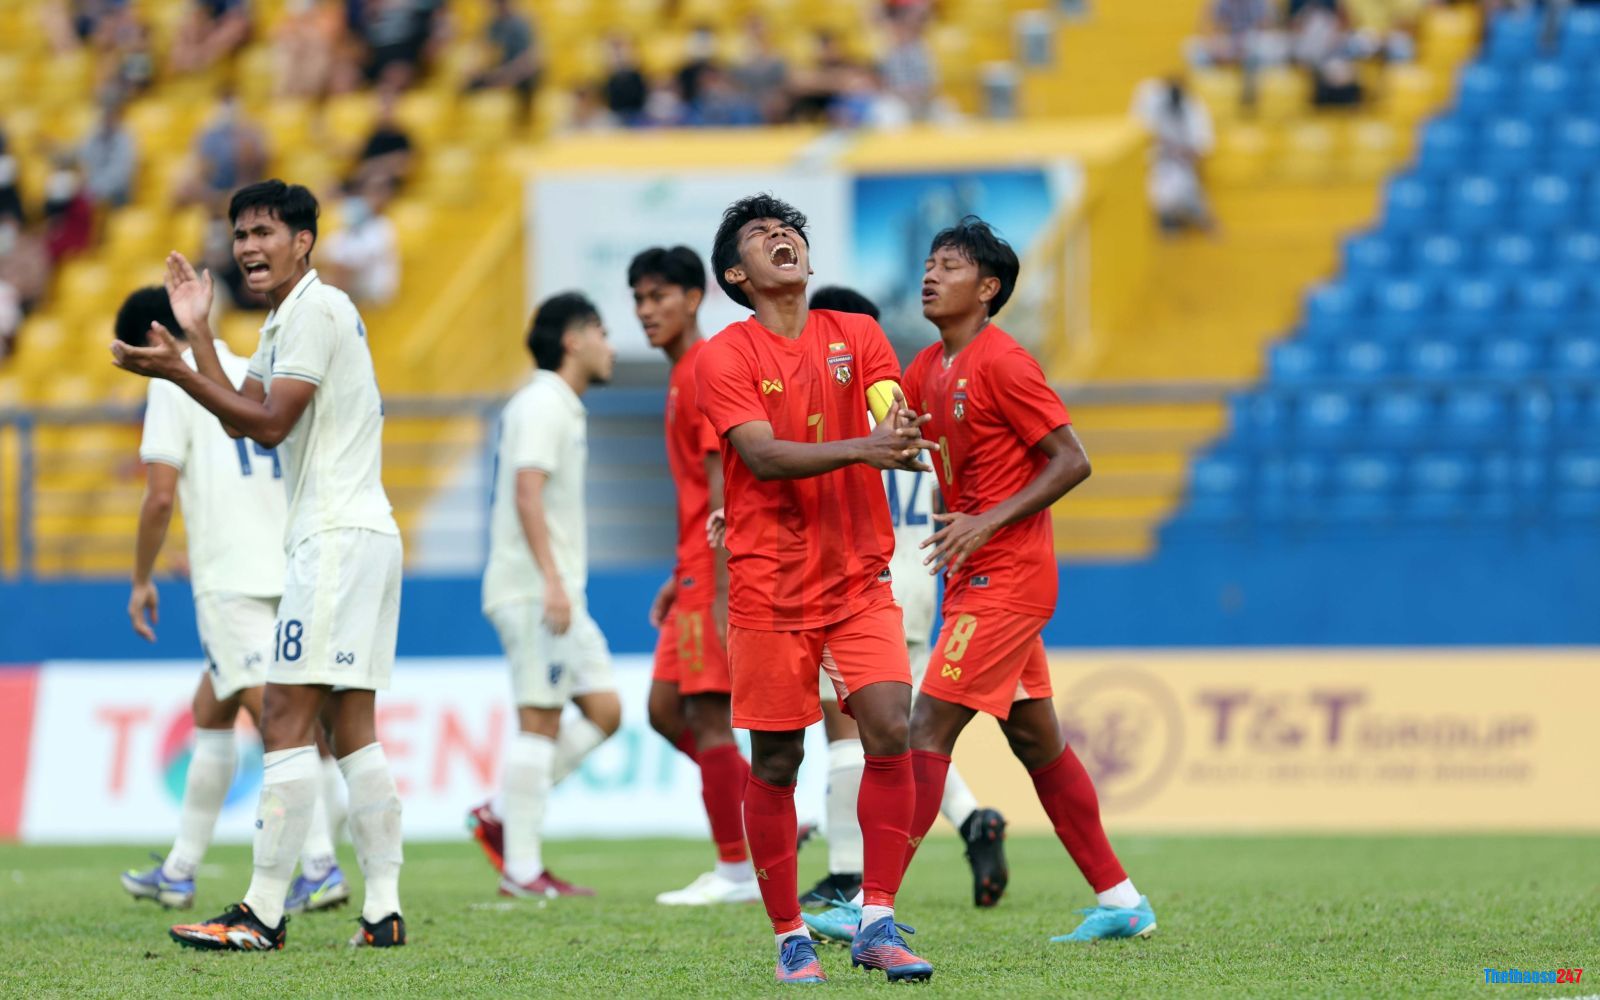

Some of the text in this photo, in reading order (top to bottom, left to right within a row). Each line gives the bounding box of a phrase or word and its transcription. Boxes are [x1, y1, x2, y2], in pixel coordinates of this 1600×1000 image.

[938, 436, 953, 486] 8
[275, 618, 303, 662] 18
[944, 613, 977, 662] 8
